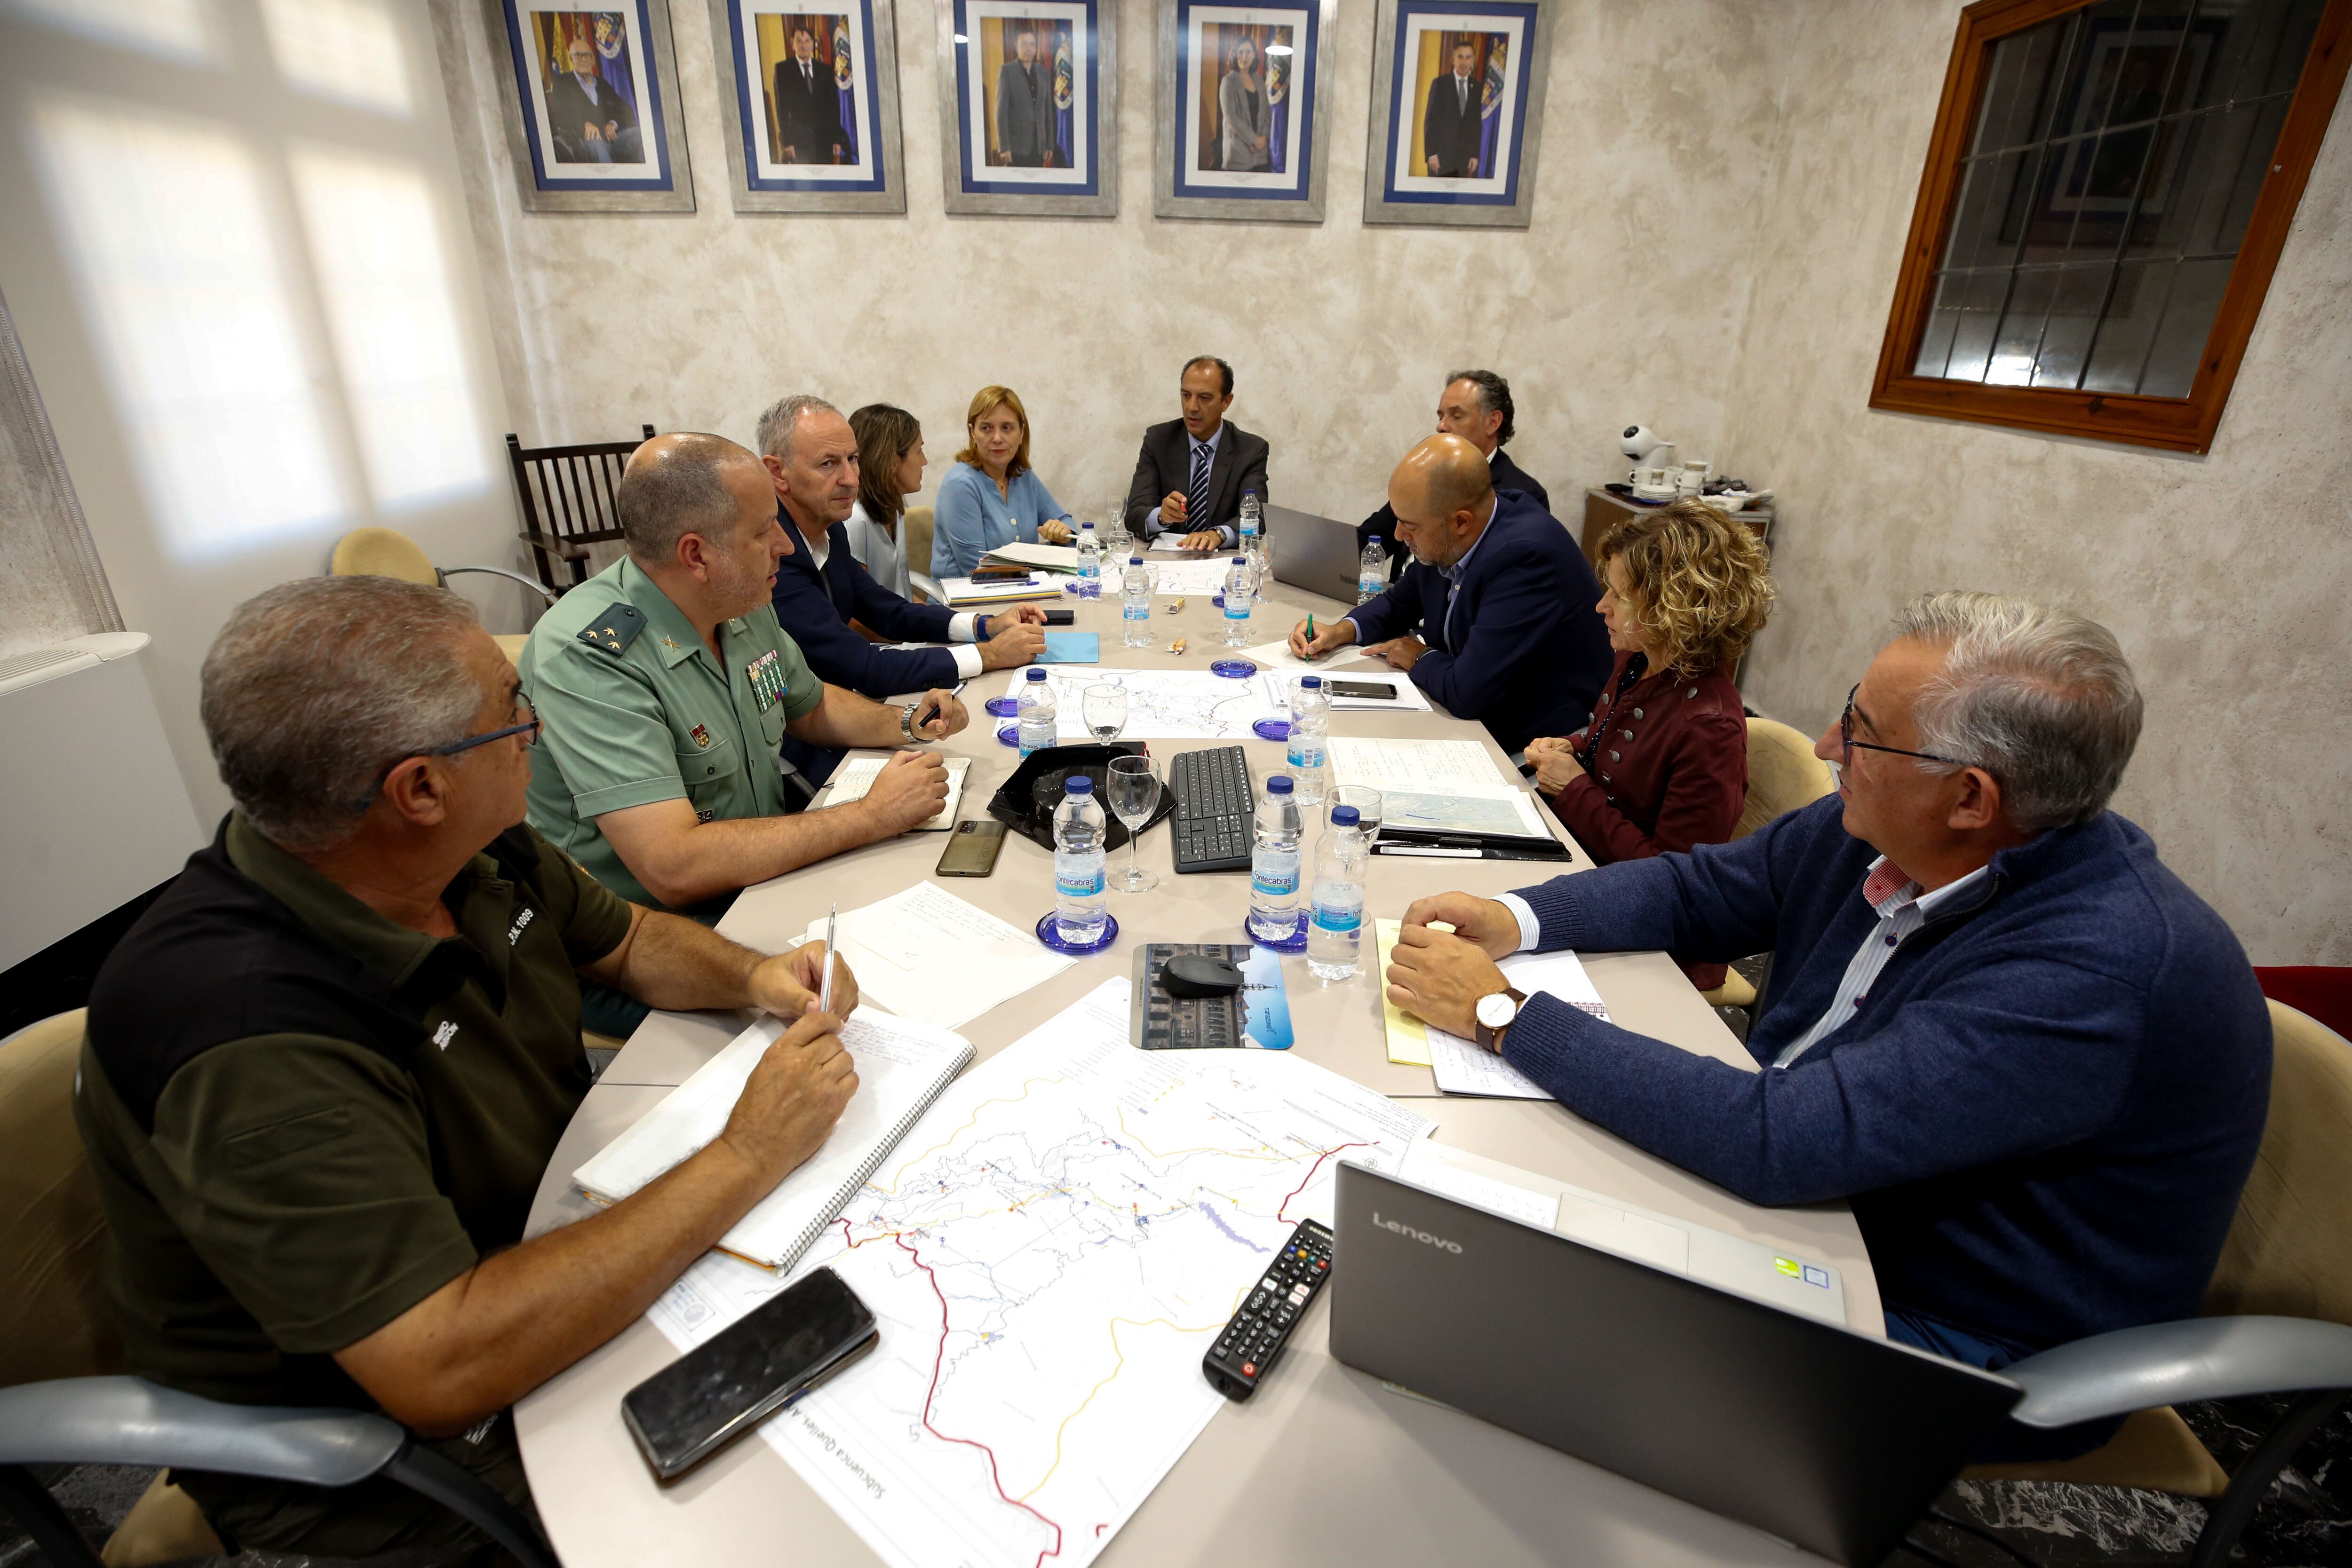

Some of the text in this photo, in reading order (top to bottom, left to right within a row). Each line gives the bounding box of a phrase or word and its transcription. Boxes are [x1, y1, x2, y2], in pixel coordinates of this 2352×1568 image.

[1057, 872, 1094, 886] Fontecabras
[1254, 870, 1292, 885] Fontecabras
[516, 908, 534, 929] 1009
[1309, 1226, 1334, 1242] AMSUNG
[1373, 1212, 1463, 1255] Lenovo
[1224, 1338, 1231, 1346] 3
[1238, 1346, 1245, 1354] 2
[836, 1448, 886, 1500] Subcuenca
